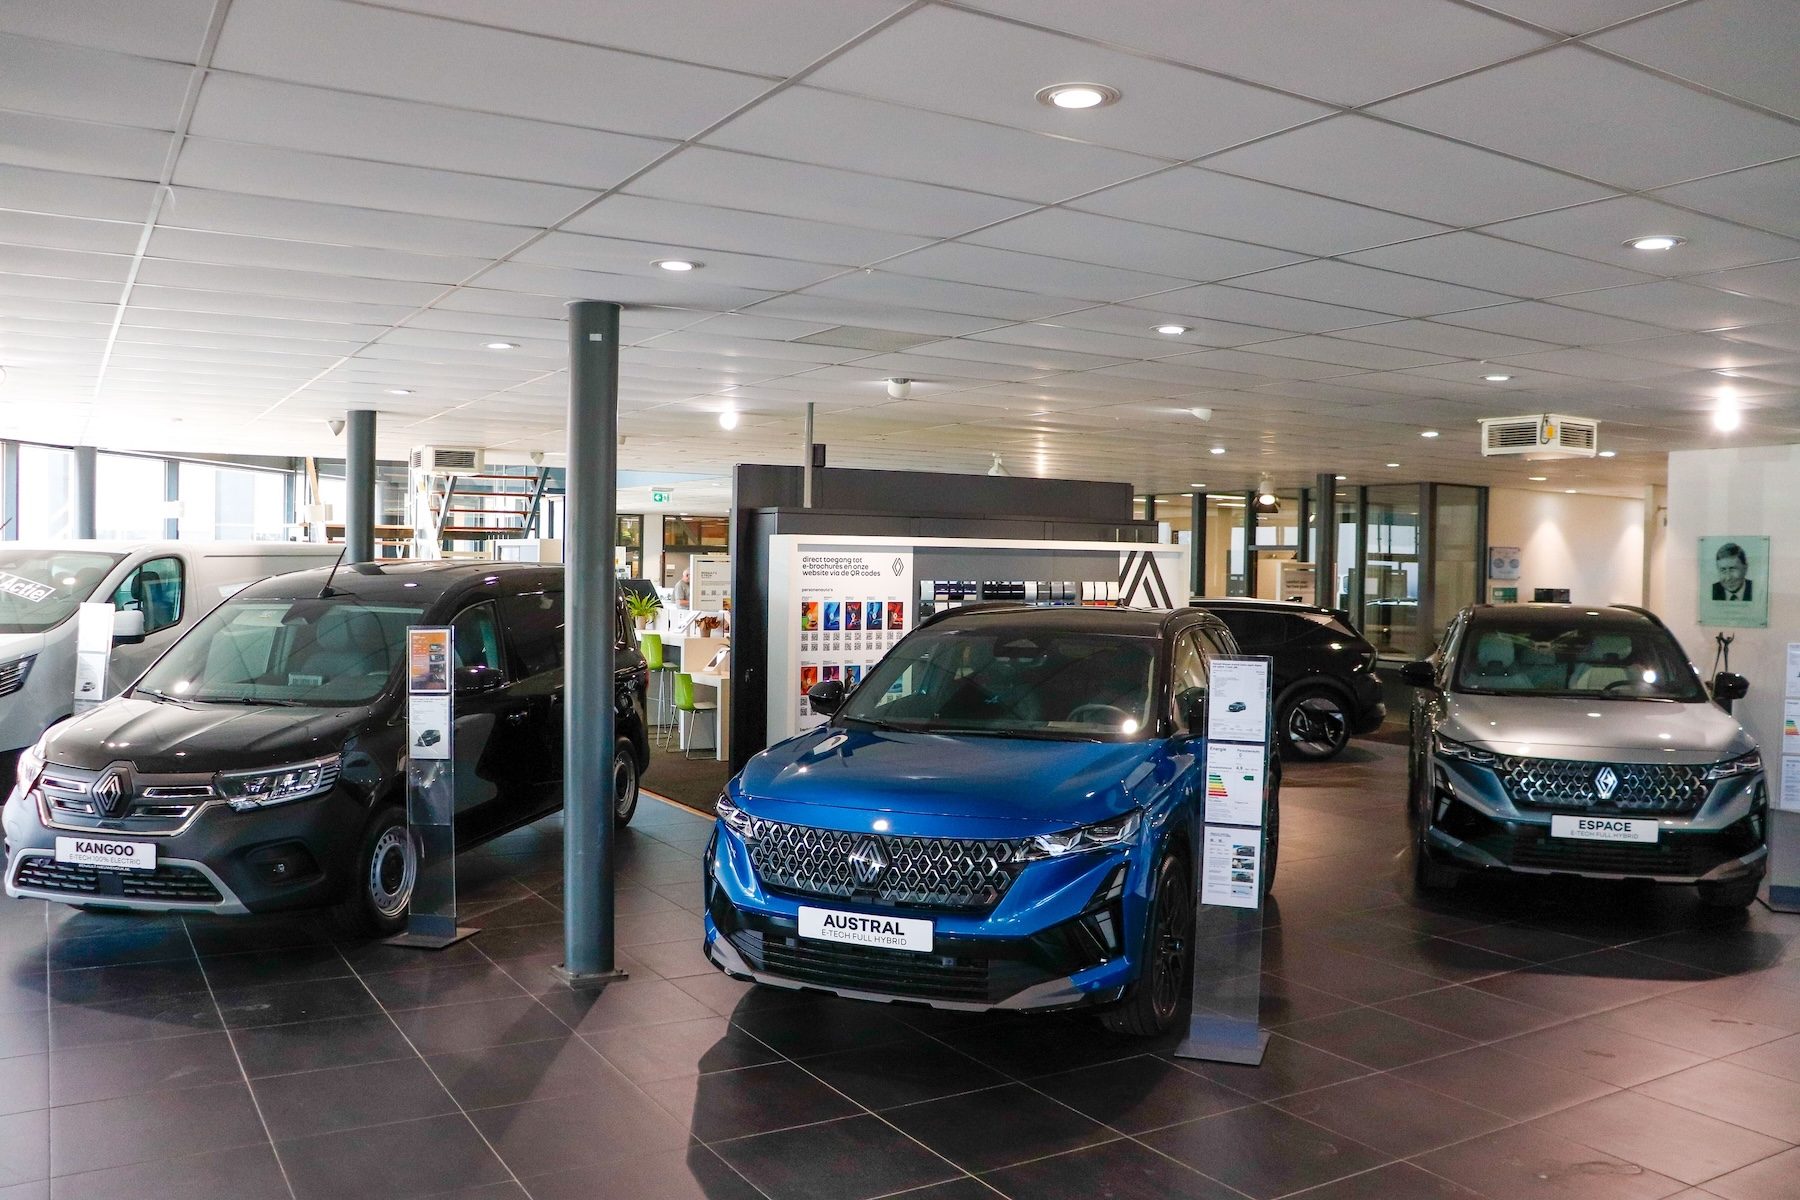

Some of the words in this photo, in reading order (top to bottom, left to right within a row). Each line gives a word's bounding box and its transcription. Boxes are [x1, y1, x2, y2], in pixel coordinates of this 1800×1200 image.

[802, 562, 843, 570] e-brochures
[1579, 819, 1632, 832] ESPACE
[75, 841, 134, 857] KANGOO
[69, 853, 92, 861] E-TECH
[110, 856, 141, 865] ELECTRIC
[823, 914, 905, 936] AUSTRAL
[821, 929, 851, 940] E-TECH
[852, 933, 872, 942] FULL
[874, 936, 907, 946] HYBRID
